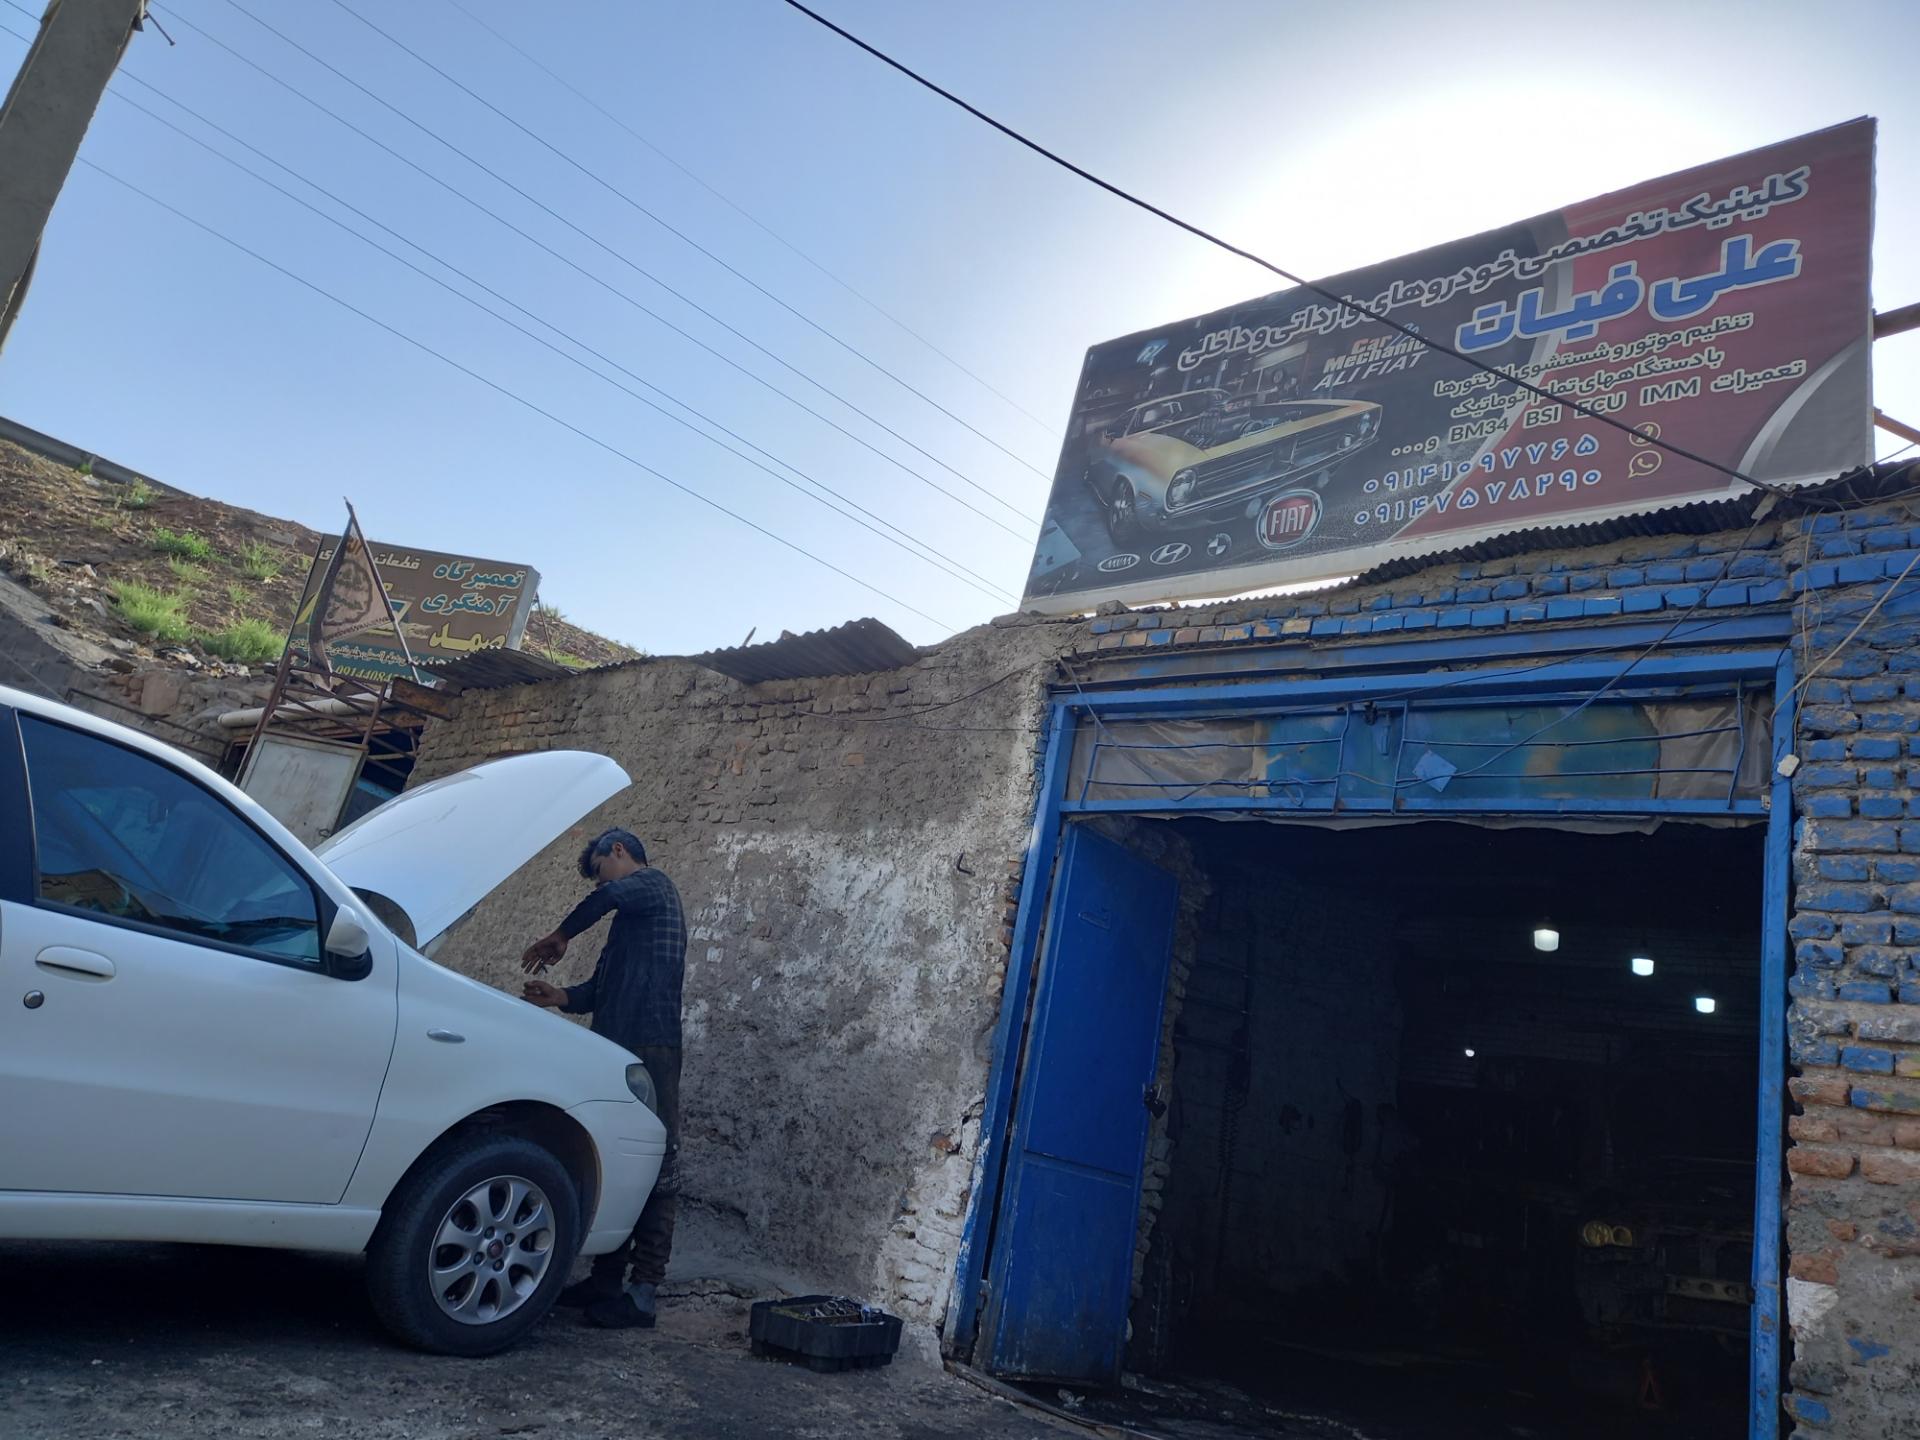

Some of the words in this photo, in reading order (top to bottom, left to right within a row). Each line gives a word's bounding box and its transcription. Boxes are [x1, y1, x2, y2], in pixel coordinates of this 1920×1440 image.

[1668, 166, 1810, 230] کلینیک
[1518, 208, 1669, 277] تخصصی
[1365, 249, 1514, 319] خودروهای
[1648, 234, 1802, 322] علی
[1269, 295, 1367, 347] وارداتی
[1455, 260, 1645, 354] فیات
[1248, 325, 1269, 354] و
[1351, 335, 1392, 355] Car
[1624, 331, 1682, 358] موتور
[1685, 312, 1753, 347] تنظیم
[1177, 325, 1251, 372] داخلی
[1323, 337, 1426, 374] Mechanic
[1516, 343, 1611, 380] شستشوی
[1611, 344, 1625, 361] و
[1704, 347, 1723, 369] با
[1312, 367, 1360, 392] ALI
[1361, 350, 1429, 380] FIAT
[1710, 360, 1807, 394] تعمیرات
[1451, 388, 1531, 418] اتوماتیک
[1574, 394, 1626, 420] ECU
[1639, 377, 1699, 407] IMM
[1450, 417, 1511, 445] BM34
[1523, 405, 1562, 429] BSI
[1363, 433, 1600, 494] ۰۹۱۴۱۰۹۷۷۶۵
[1354, 469, 1602, 525] ۰۹۱۴۷۵۷۸۲۹۰
[1270, 503, 1310, 536] FIAT
[374, 553, 421, 570] قطعات
[421, 593, 517, 616] آهنگری
